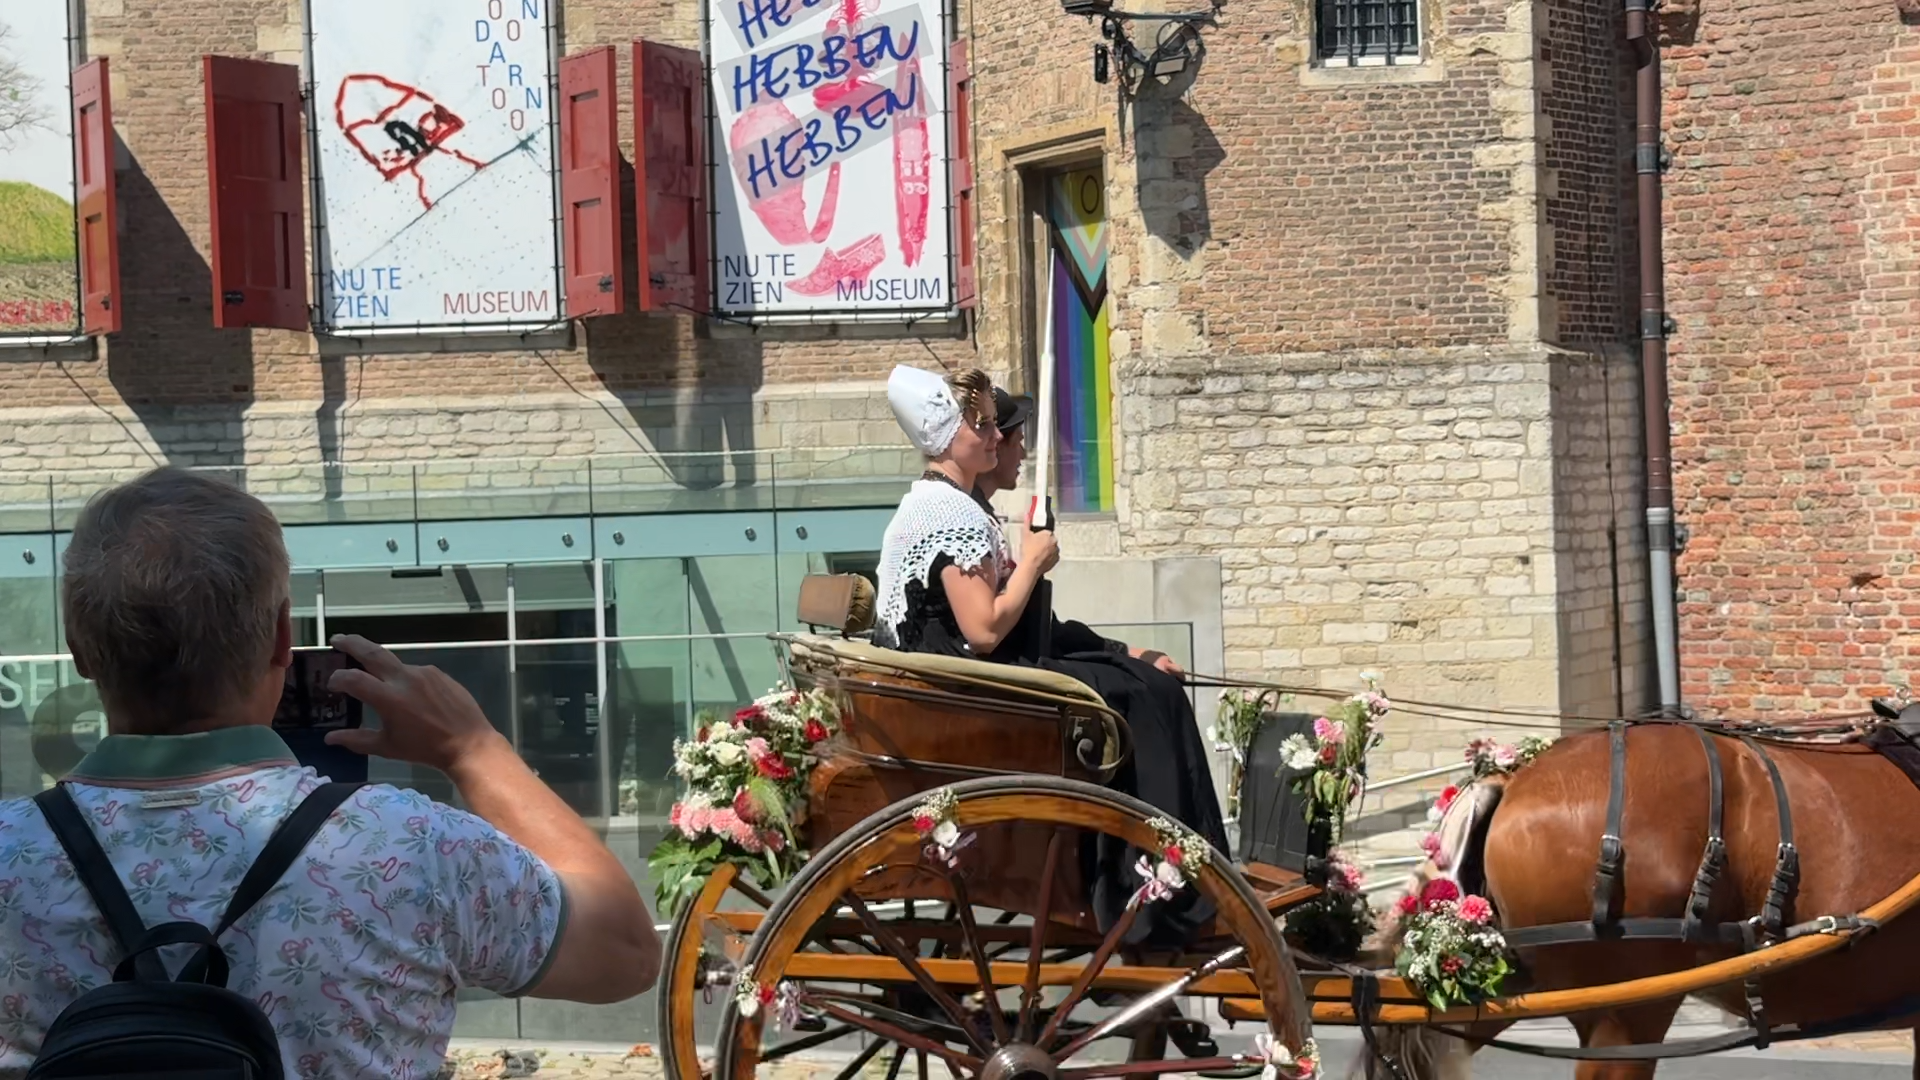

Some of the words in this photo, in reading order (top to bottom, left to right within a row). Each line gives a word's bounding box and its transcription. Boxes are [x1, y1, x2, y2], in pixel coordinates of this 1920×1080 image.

[733, 20, 919, 112] HEBBEN
[748, 72, 916, 198] HEBBEN
[724, 255, 759, 278] NU
[766, 253, 796, 276] TE
[330, 269, 365, 292] NU
[372, 267, 402, 290] TE
[836, 277, 941, 302] MUSEUM
[443, 290, 549, 315] MUSEUM
[725, 281, 783, 305] ZIEN
